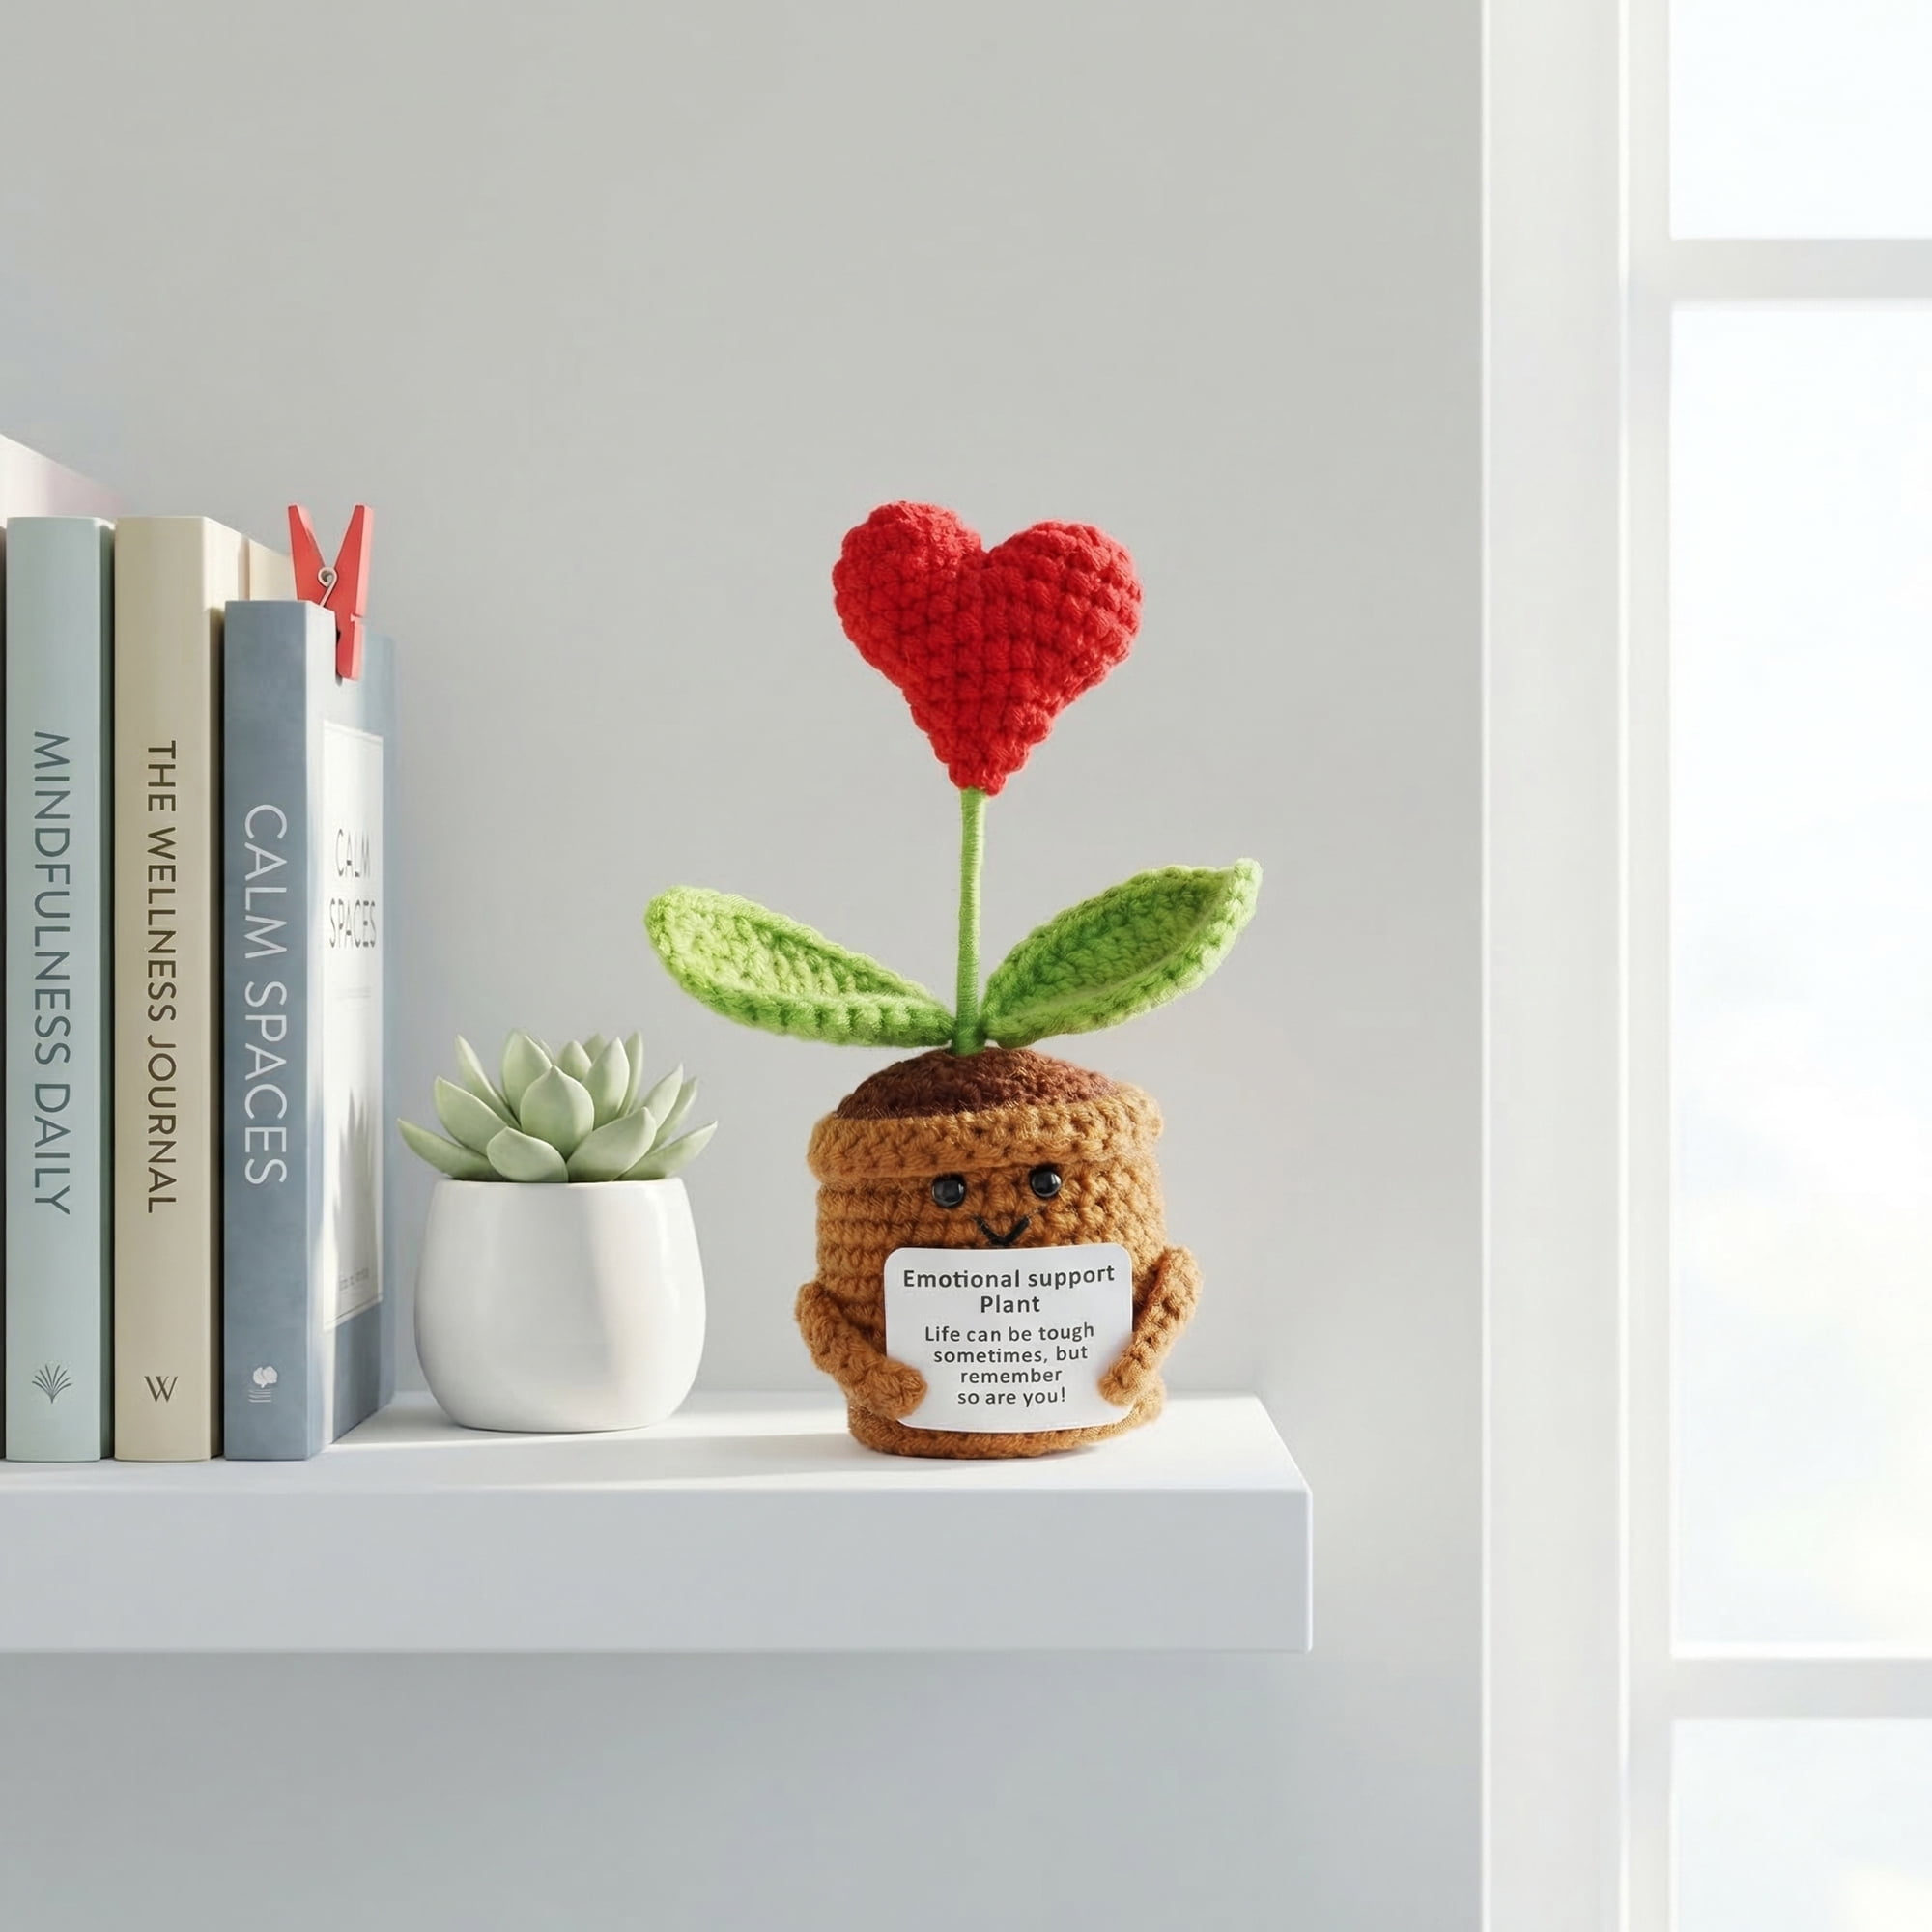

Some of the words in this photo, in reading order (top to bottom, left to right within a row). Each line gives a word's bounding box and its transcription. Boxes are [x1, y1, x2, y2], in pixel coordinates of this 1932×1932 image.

[147, 740, 177, 812] THE
[335, 828, 371, 878] CALM
[34, 731, 71, 1065] MINDFULNESS
[244, 805, 288, 959] CALM
[147, 827, 177, 1022] WELLNESS
[329, 897, 377, 949] SPACES
[244, 981, 288, 1184] SPACES
[34, 1083, 71, 1215] DAILY
[147, 1035, 177, 1214] JOURNAL
[903, 1268, 1020, 1289] Emotional
[1028, 1264, 1116, 1291] support
[980, 1294, 1041, 1314] Plant
[924, 1325, 961, 1343] Life
[966, 1329, 1002, 1343] can
[1009, 1325, 1033, 1343] be
[1037, 1321, 1094, 1343] tough
[933, 1348, 1048, 1364] sometimes,
[1056, 1345, 1089, 1361] but
[144, 1375, 179, 1403] W
[957, 1392, 980, 1406] so
[984, 1392, 1017, 1406] are
[1022, 1386, 1066, 1408] you!
[960, 1368, 1063, 1384] remember
